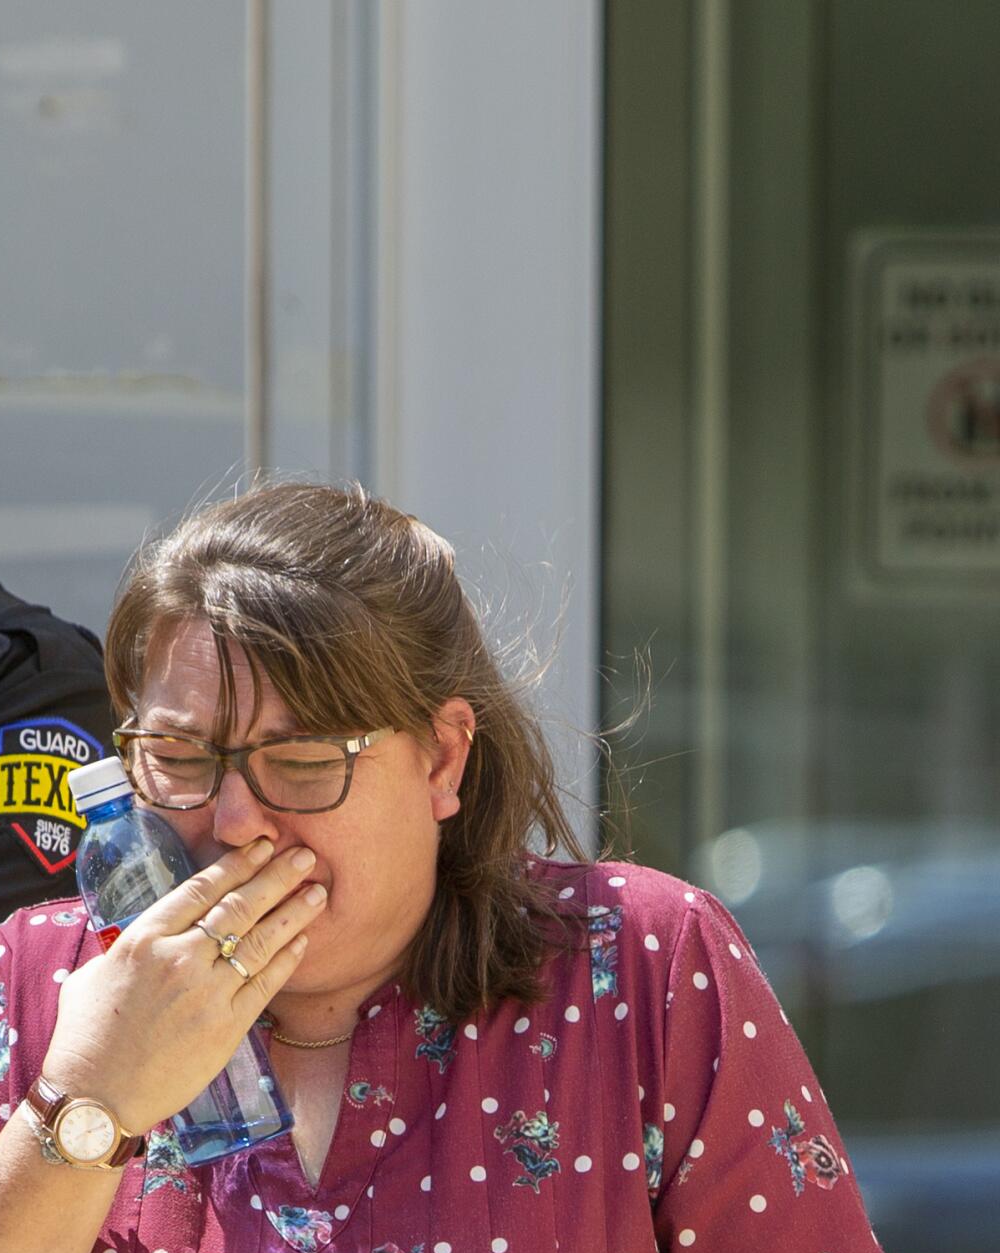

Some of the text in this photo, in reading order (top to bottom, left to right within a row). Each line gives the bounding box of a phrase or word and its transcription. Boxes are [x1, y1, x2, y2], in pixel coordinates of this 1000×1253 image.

[19, 728, 90, 762] GUARD
[36, 819, 71, 841] SINCE
[34, 831, 70, 856] 1976
